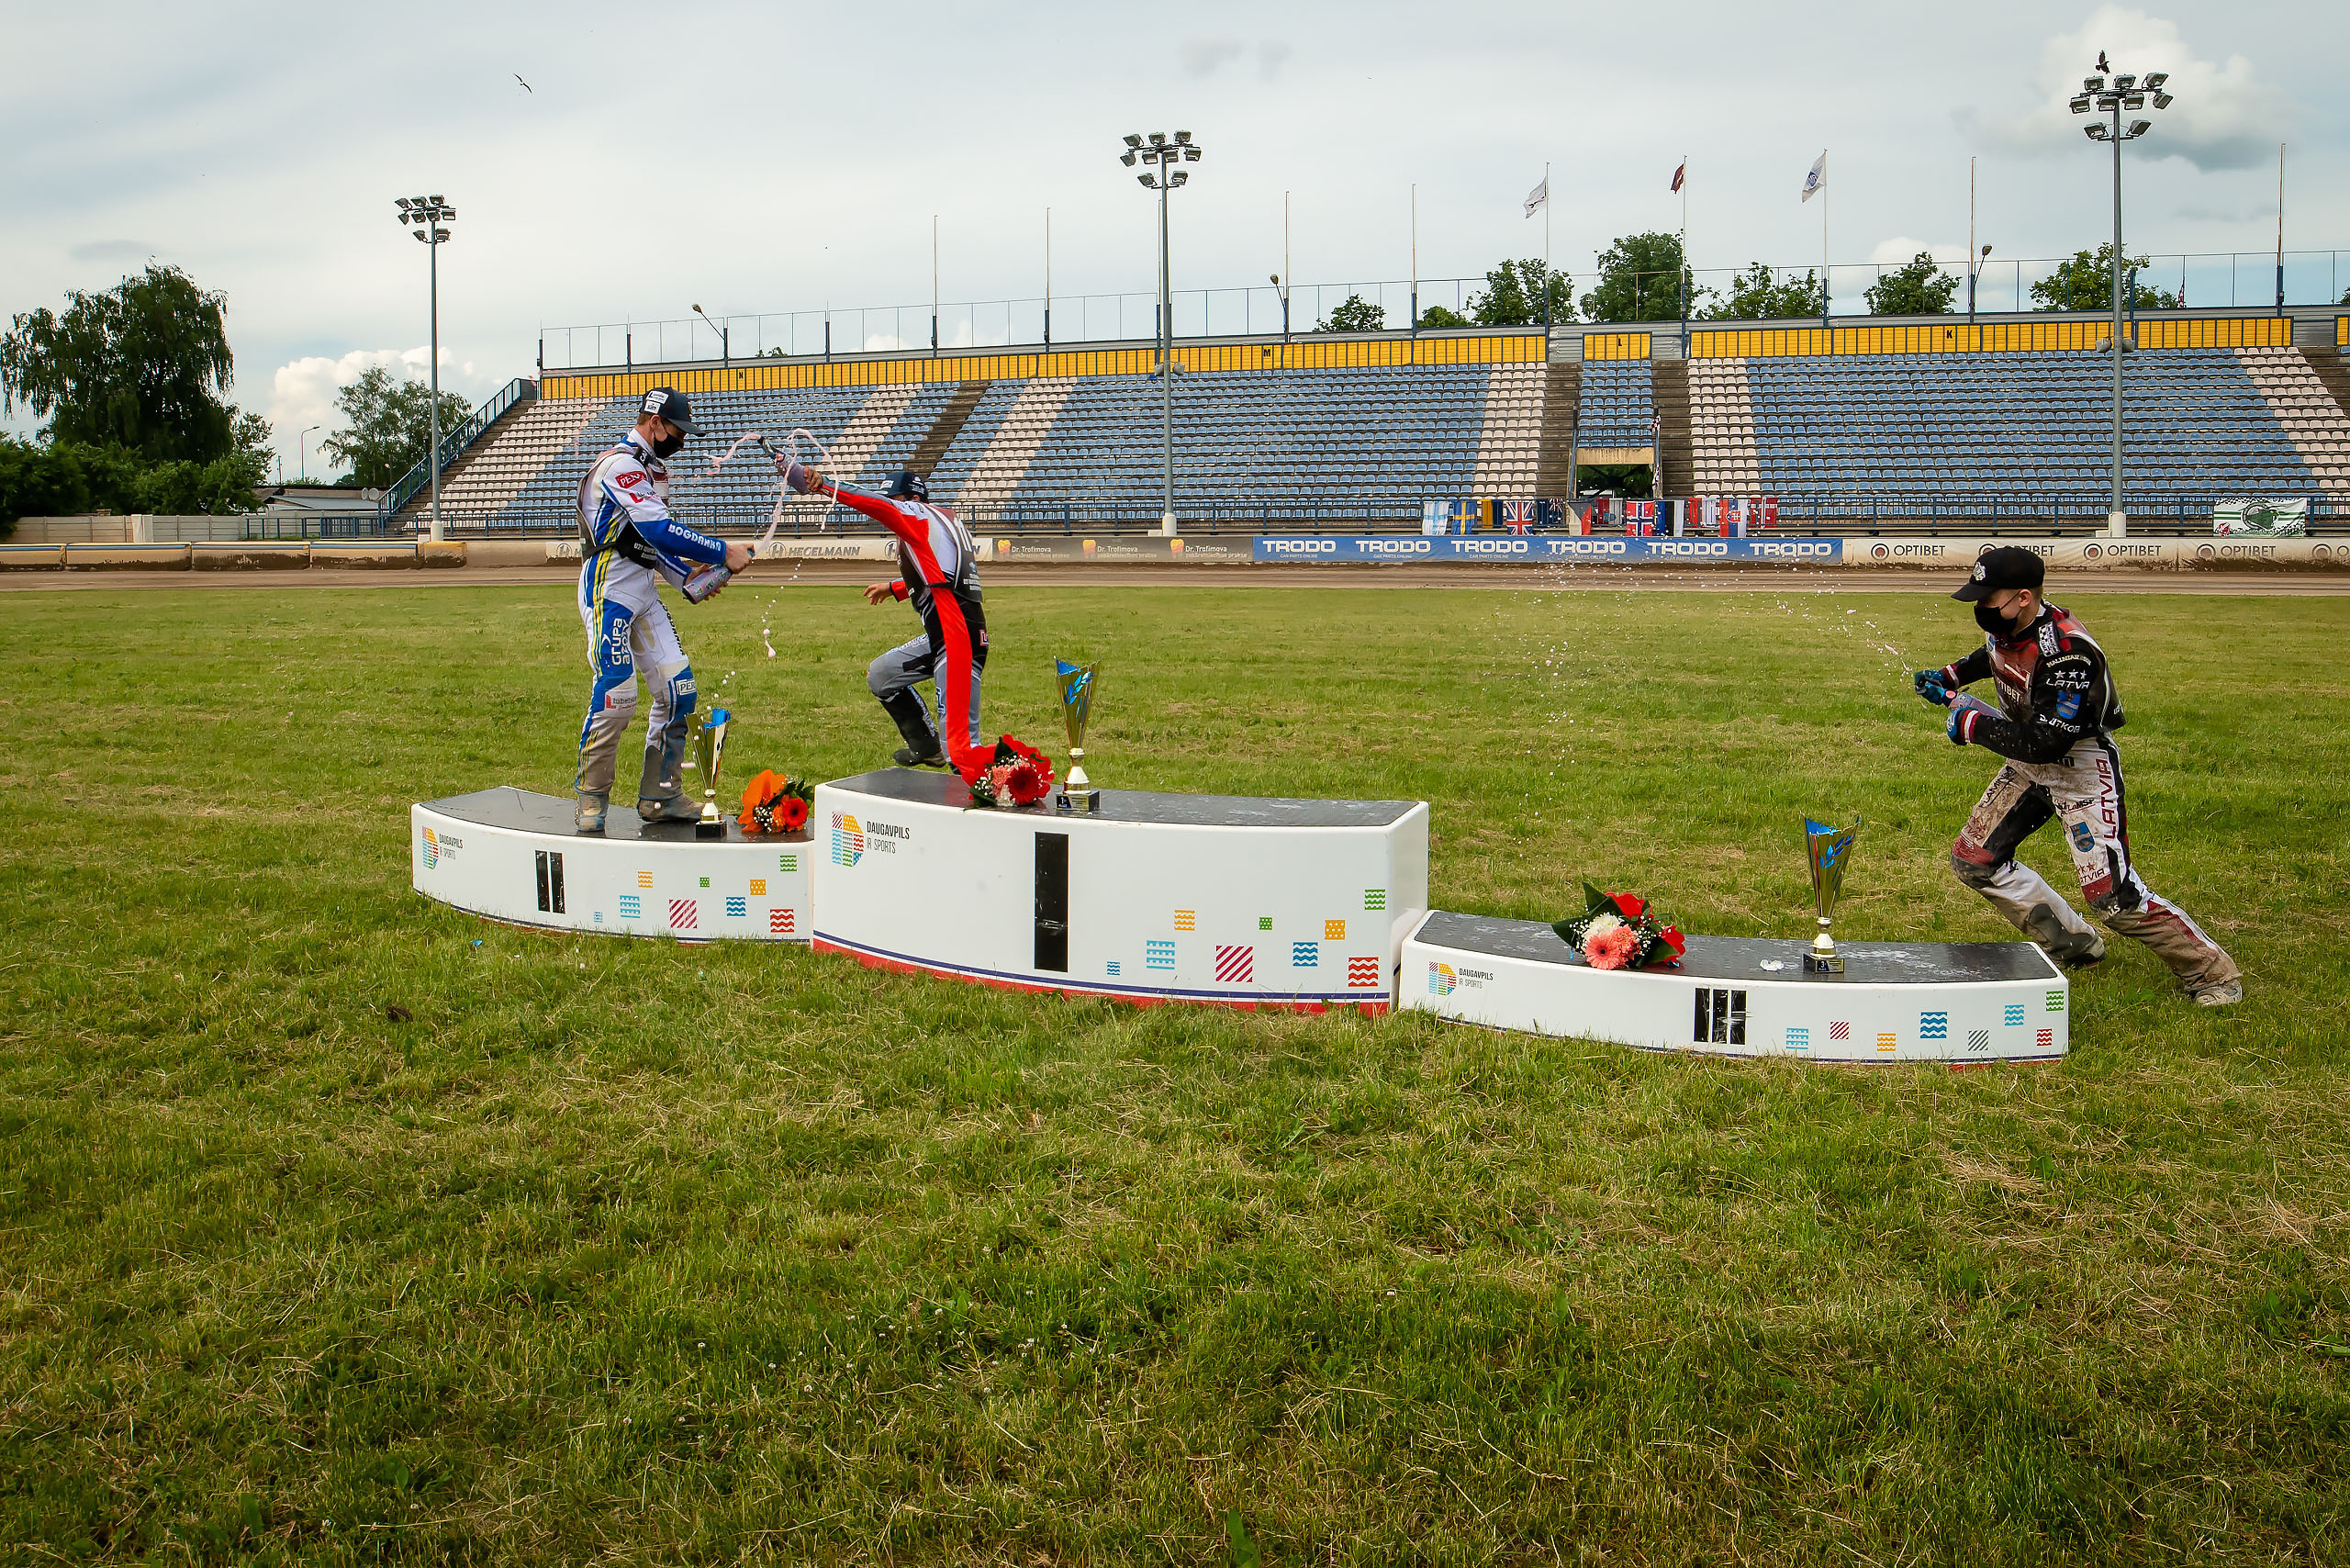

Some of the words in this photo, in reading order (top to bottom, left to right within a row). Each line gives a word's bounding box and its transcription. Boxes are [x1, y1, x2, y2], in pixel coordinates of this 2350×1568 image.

[1946, 330, 1953, 339] K
[1618, 338, 1622, 346] L
[1263, 349, 1270, 357] M
[739, 371, 744, 379] N
[667, 523, 722, 551] BOGDANKA
[789, 546, 861, 556] HEGELMANN
[1262, 540, 1337, 553] TRODO
[1355, 540, 1431, 553] TRODO
[1450, 540, 1528, 553] TRODO
[1547, 541, 1627, 554] TRODO
[1647, 542, 1729, 555] TRODO
[1749, 543, 1832, 556] TRODO
[1893, 544, 1946, 556] OPTIBET
[2107, 544, 2162, 557] OPTIBET
[2220, 544, 2277, 557] OPTIBET
[2095, 758, 2117, 839] LATVIA
[867, 820, 911, 840] DAUGAVPILS
[439, 834, 464, 849] DAUGAVPILS
[873, 838, 896, 854] SPORTS
[443, 847, 456, 860] SPORTS
[534, 849, 566, 915] II
[1459, 968, 1494, 980] DAUGAVPILS
[1465, 979, 1483, 990] SPORTS
[1693, 987, 1748, 1046] III
